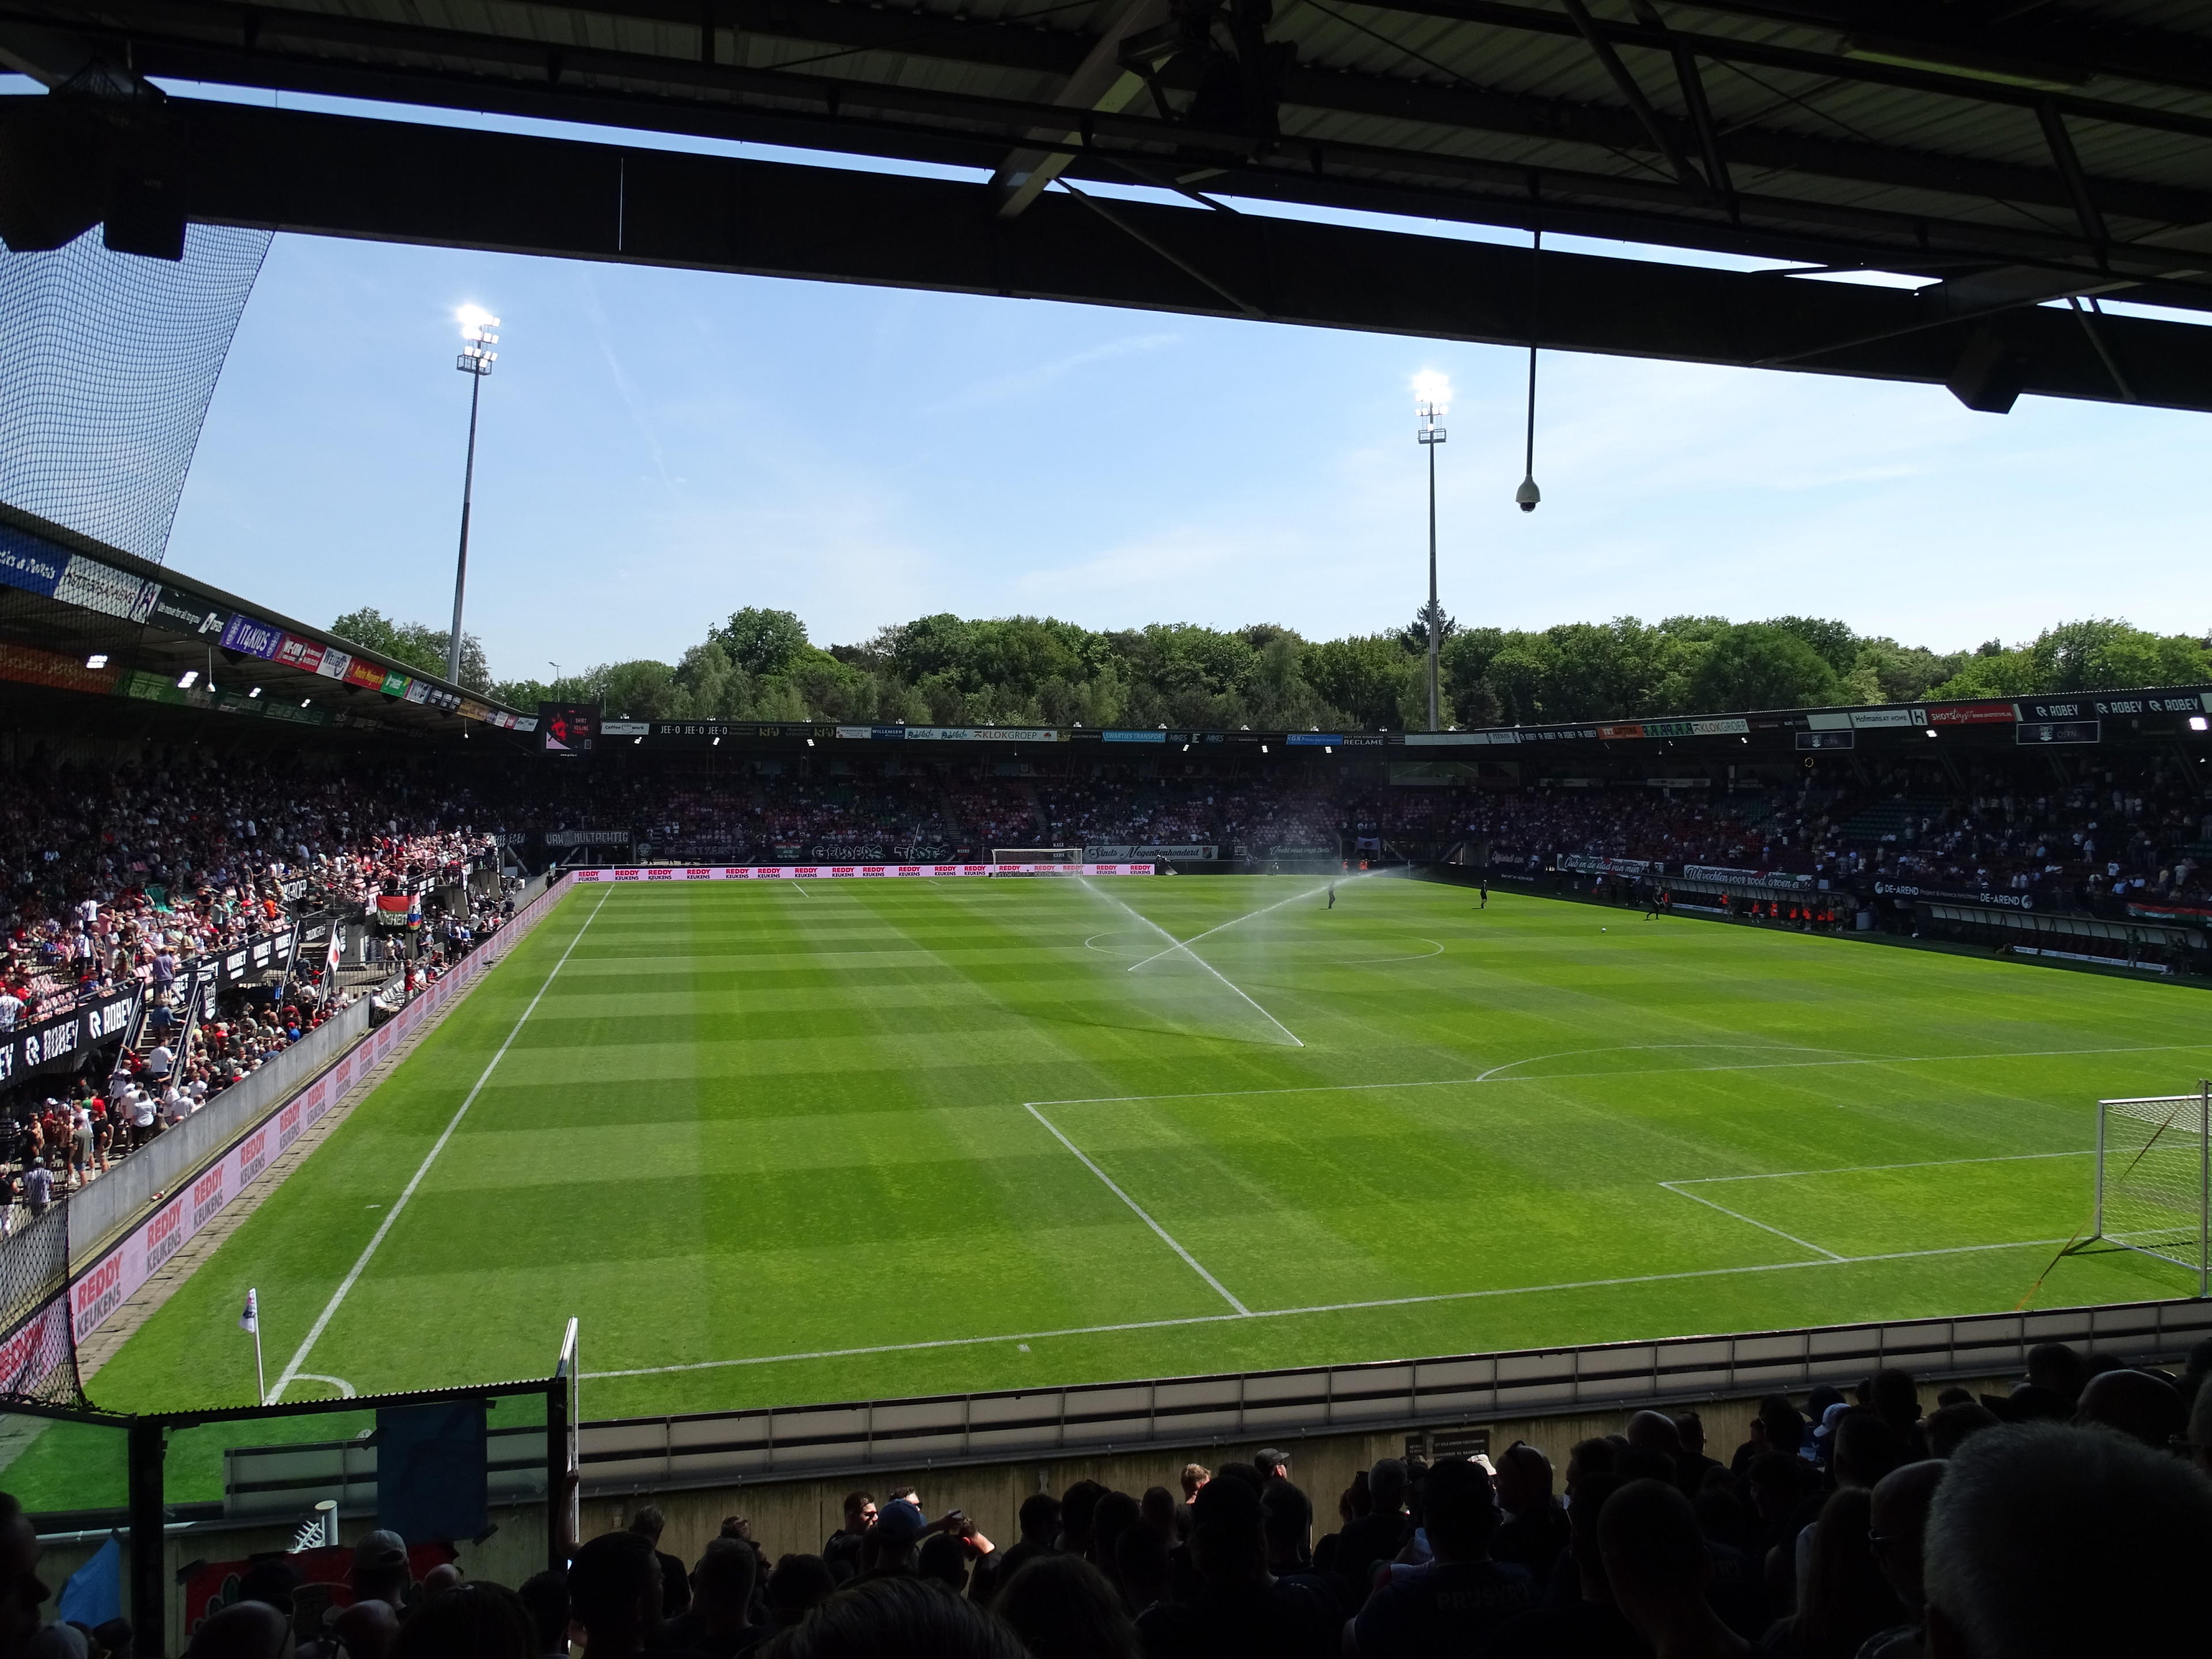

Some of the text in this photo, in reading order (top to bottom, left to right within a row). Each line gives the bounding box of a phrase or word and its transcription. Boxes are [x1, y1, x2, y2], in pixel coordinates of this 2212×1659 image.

[237, 624, 270, 651] IT4KIDS
[2049, 704, 2078, 716] ROBEY
[2111, 700, 2143, 713] ROBEY
[2164, 698, 2199, 711] ROBEY
[660, 725, 680, 734] JEE-O
[684, 726, 704, 734] JEE-O
[708, 726, 728, 735] JEE-O
[1700, 722, 1746, 732] KLOKGROEP
[1855, 715, 1882, 723] Hofmans
[983, 731, 1037, 740] KLOKGROEP
[1089, 847, 1118, 859] Sinds
[1565, 857, 1578, 868] Club
[1596, 862, 1611, 870] stad
[1702, 871, 1728, 881] vechten
[1885, 885, 1919, 895] DE-AREND
[1980, 893, 2020, 905] DE-AREND
[253, 941, 272, 960] UNIBET
[275, 933, 291, 951] UNIBET
[226, 950, 247, 971] UNIBET
[103, 997, 132, 1035] ROBEY
[43, 1019, 79, 1062] ROBEY
[336, 1058, 351, 1084] REDDY
[308, 1080, 326, 1109] REDDY
[280, 1100, 301, 1134] REDDY
[308, 1099, 326, 1126] KEUKENS
[280, 1121, 300, 1151] KEUKENS
[241, 1130, 266, 1168] REDDY
[240, 1152, 266, 1187] KEUKENS
[194, 1164, 224, 1209] REDDY
[194, 1189, 224, 1230] KEUKENS
[147, 1199, 183, 1251] REDDY
[147, 1227, 181, 1274] KEUKENS
[78, 1251, 124, 1314] REDDY
[77, 1282, 122, 1339] KEUKENS
